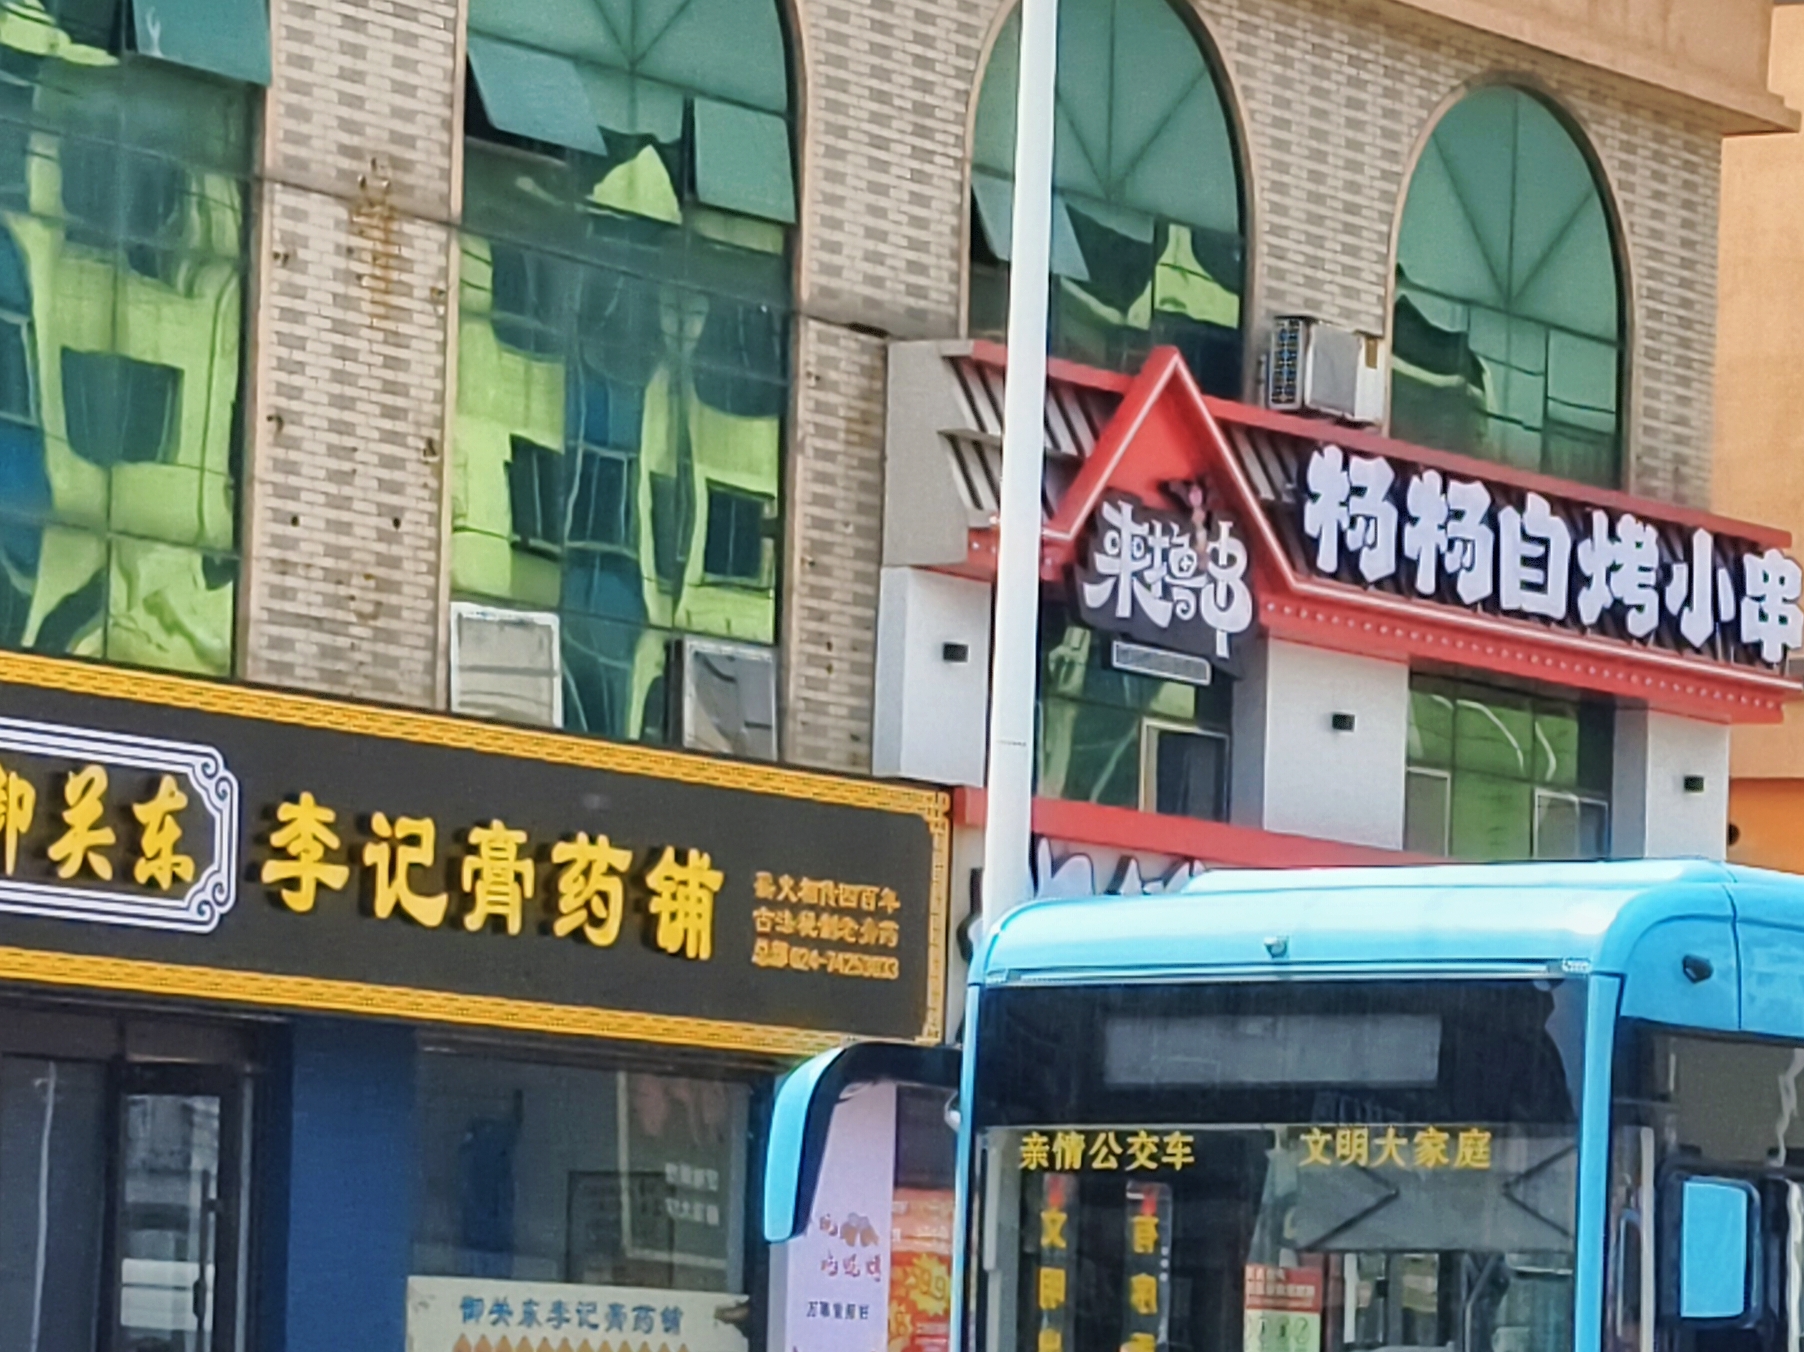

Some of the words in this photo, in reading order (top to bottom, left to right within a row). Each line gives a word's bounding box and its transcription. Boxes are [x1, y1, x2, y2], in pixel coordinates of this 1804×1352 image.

[1304, 444, 1804, 664] 杨杨自烤小串
[261, 791, 724, 960] 李记膏药铺
[1019, 1130, 1195, 1171] 亲情公交车
[1299, 1127, 1491, 1171] 文明大家庭
